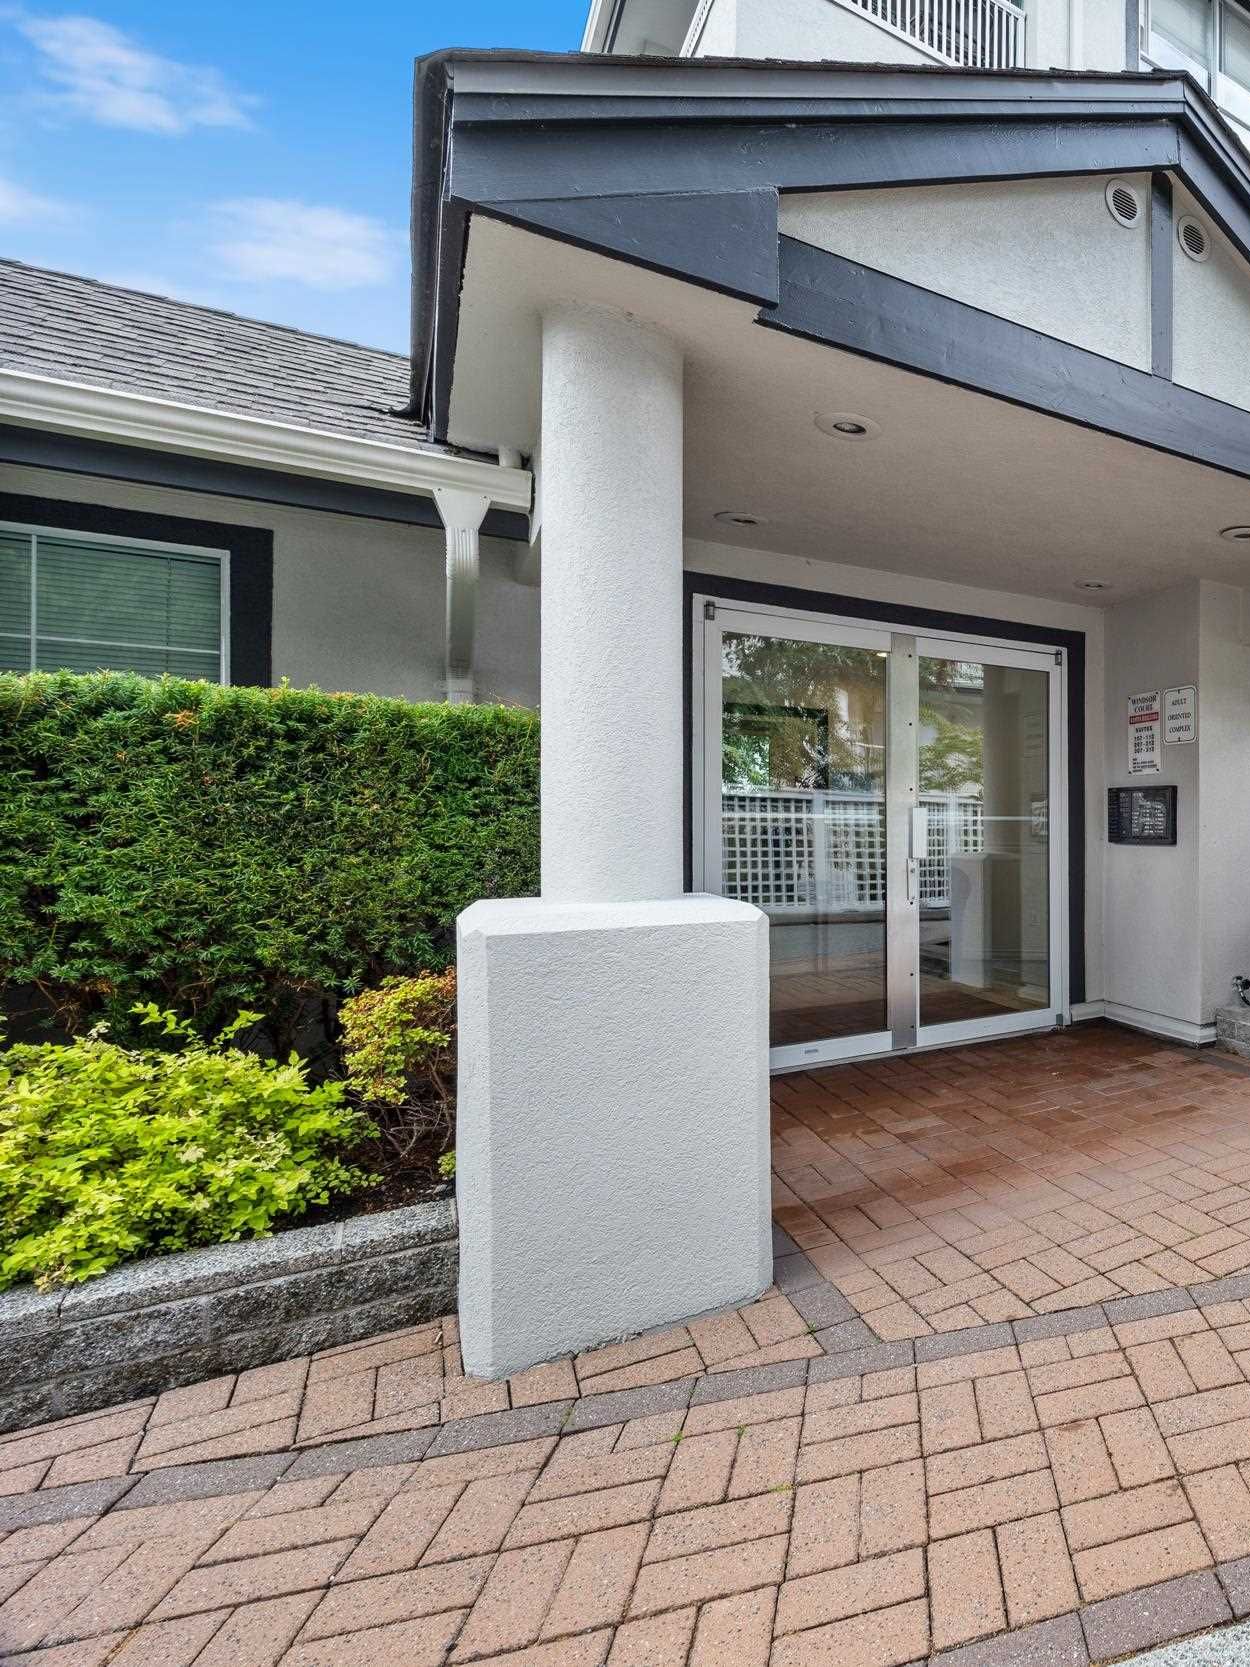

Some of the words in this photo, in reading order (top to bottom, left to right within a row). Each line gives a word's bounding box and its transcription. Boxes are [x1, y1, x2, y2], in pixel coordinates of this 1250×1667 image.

[1131, 695, 1157, 705] WINDSOR
[1134, 704, 1153, 713] COURT
[1168, 712, 1192, 721] ORIENTED
[1169, 725, 1191, 734] COMPLEX
